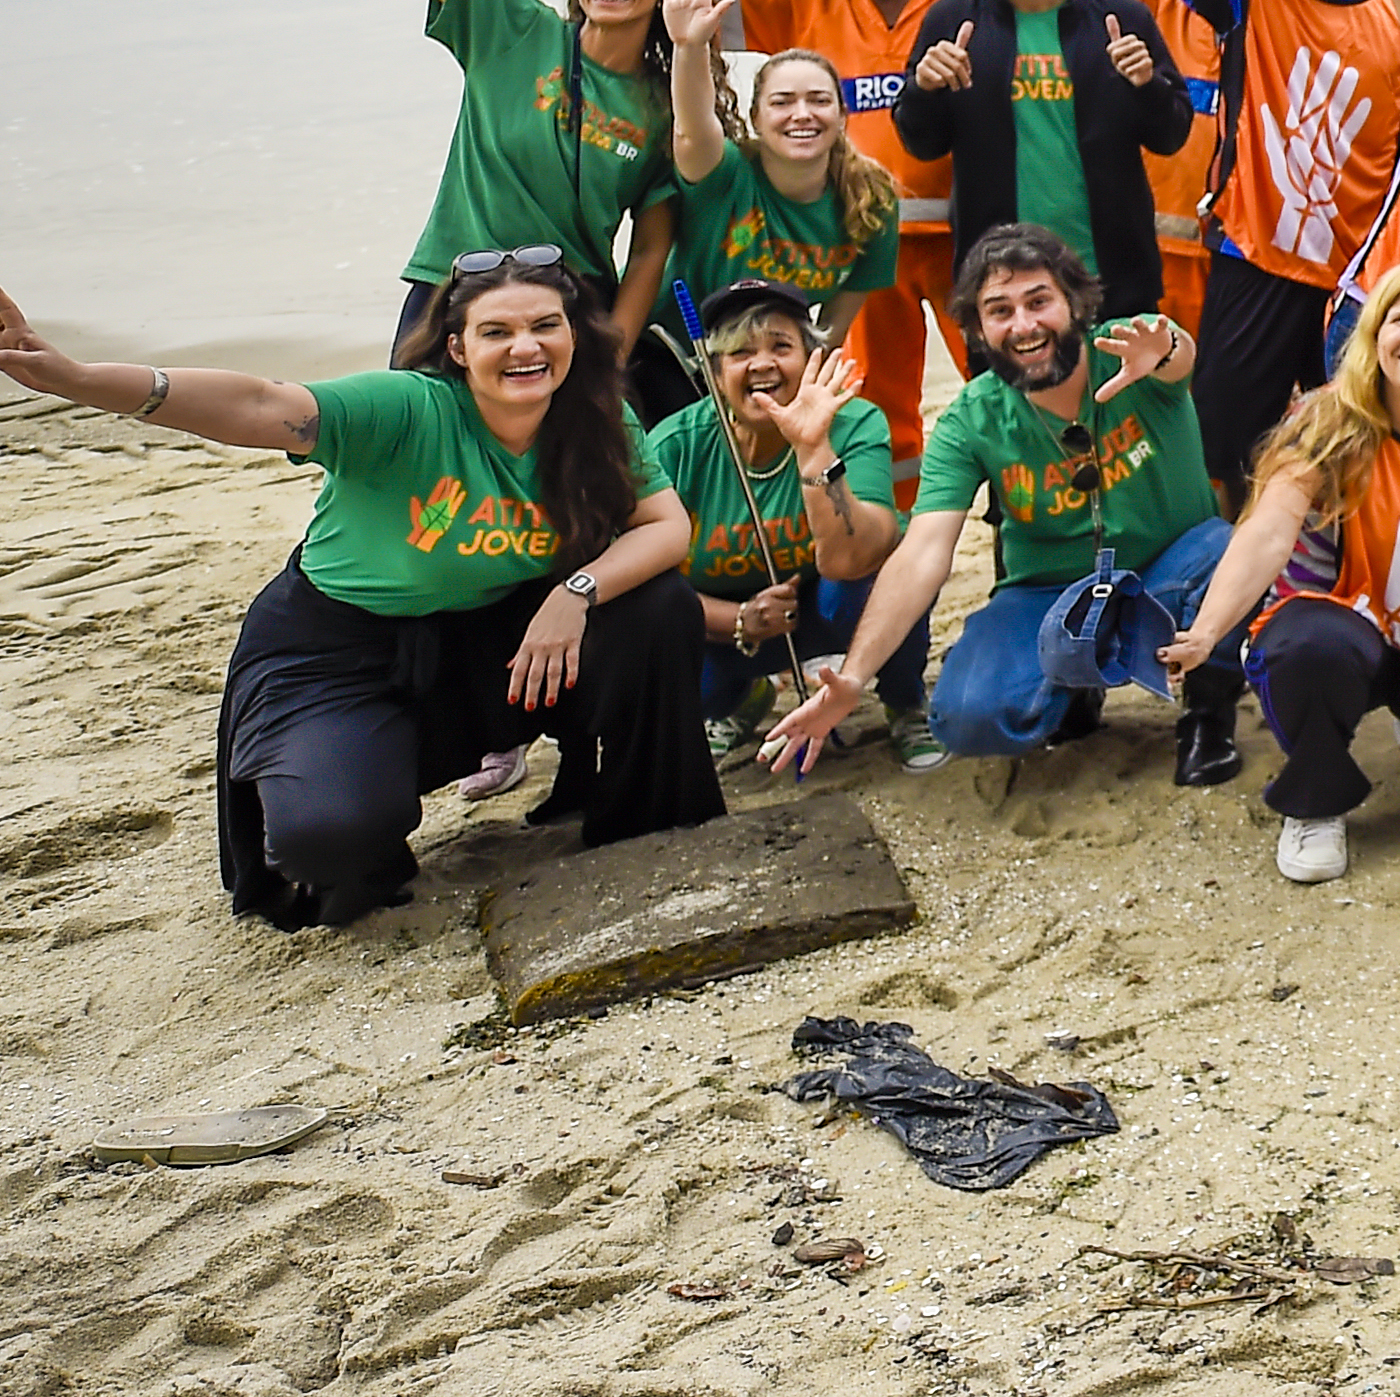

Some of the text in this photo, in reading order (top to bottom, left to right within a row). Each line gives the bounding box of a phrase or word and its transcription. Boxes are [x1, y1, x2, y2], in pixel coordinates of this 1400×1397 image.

[855, 74, 905, 101] RIO
[1011, 79, 1074, 101] OVEM
[1047, 440, 1153, 516] JOM BR
